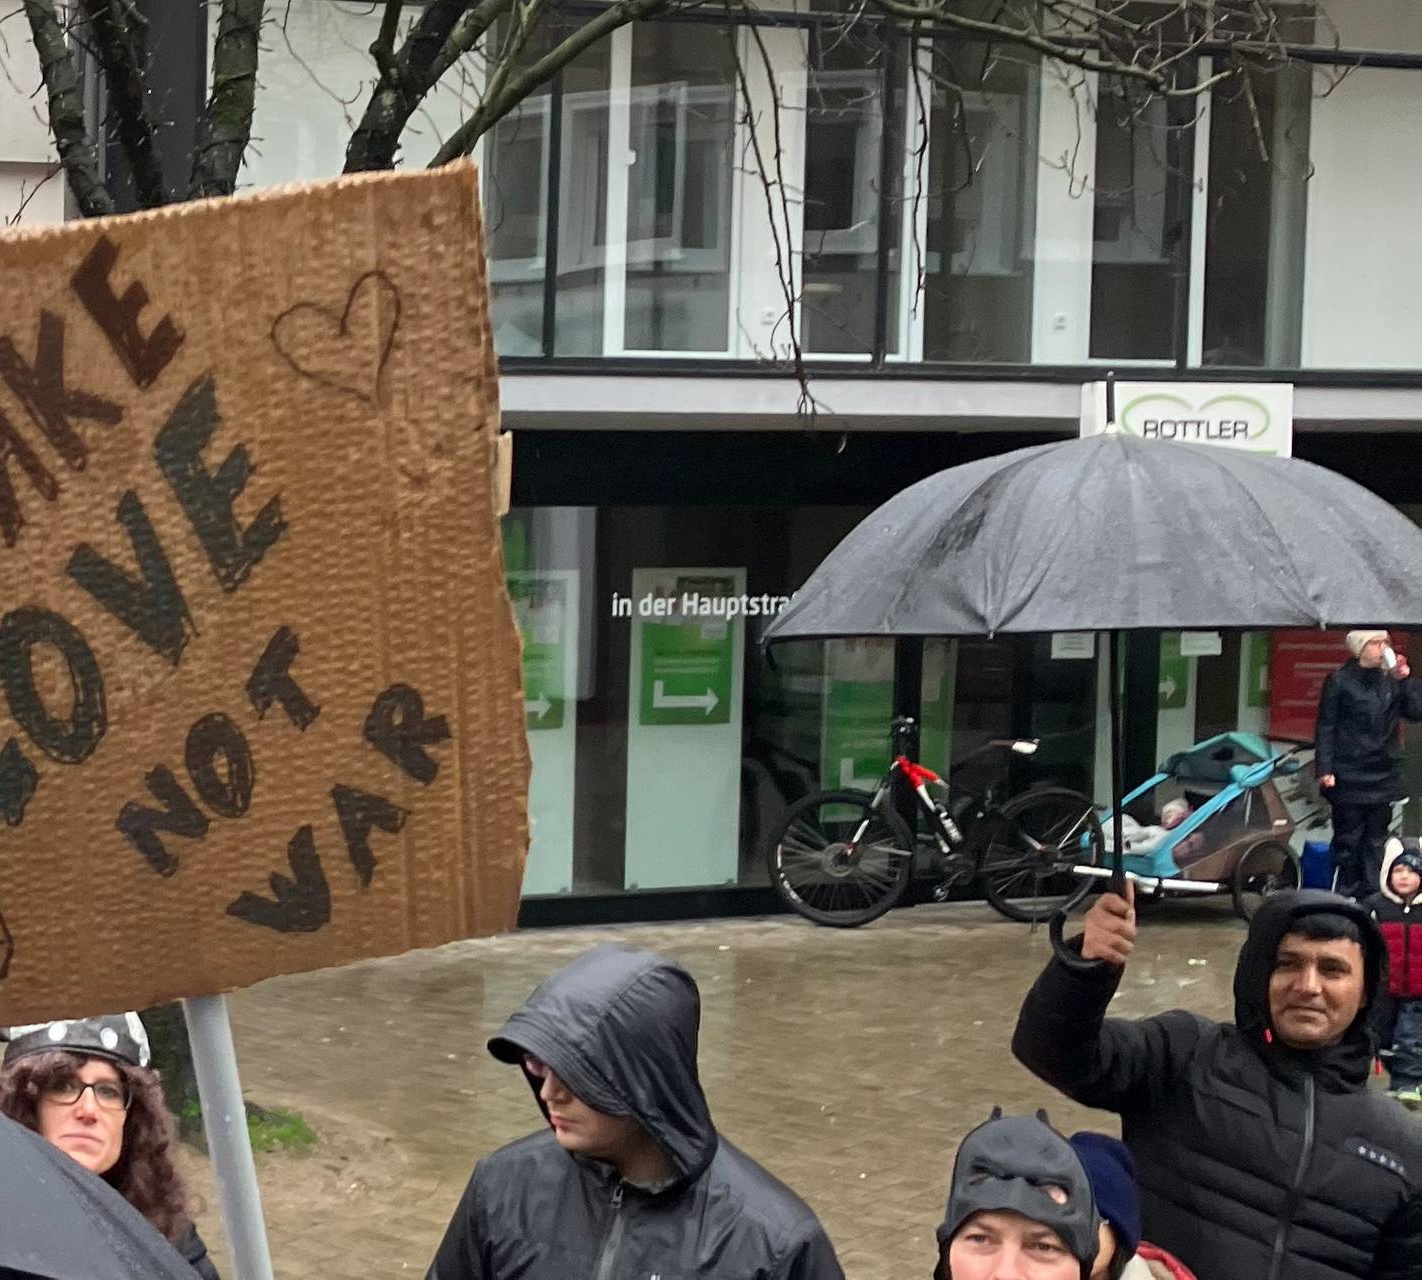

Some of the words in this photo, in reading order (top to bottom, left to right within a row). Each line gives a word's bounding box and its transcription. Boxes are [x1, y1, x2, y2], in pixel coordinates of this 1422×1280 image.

[1143, 419, 1249, 439] ROTTLER
[612, 592, 632, 616] in
[639, 592, 676, 616] der
[115, 625, 321, 876] NOT
[226, 683, 452, 933] WAR
